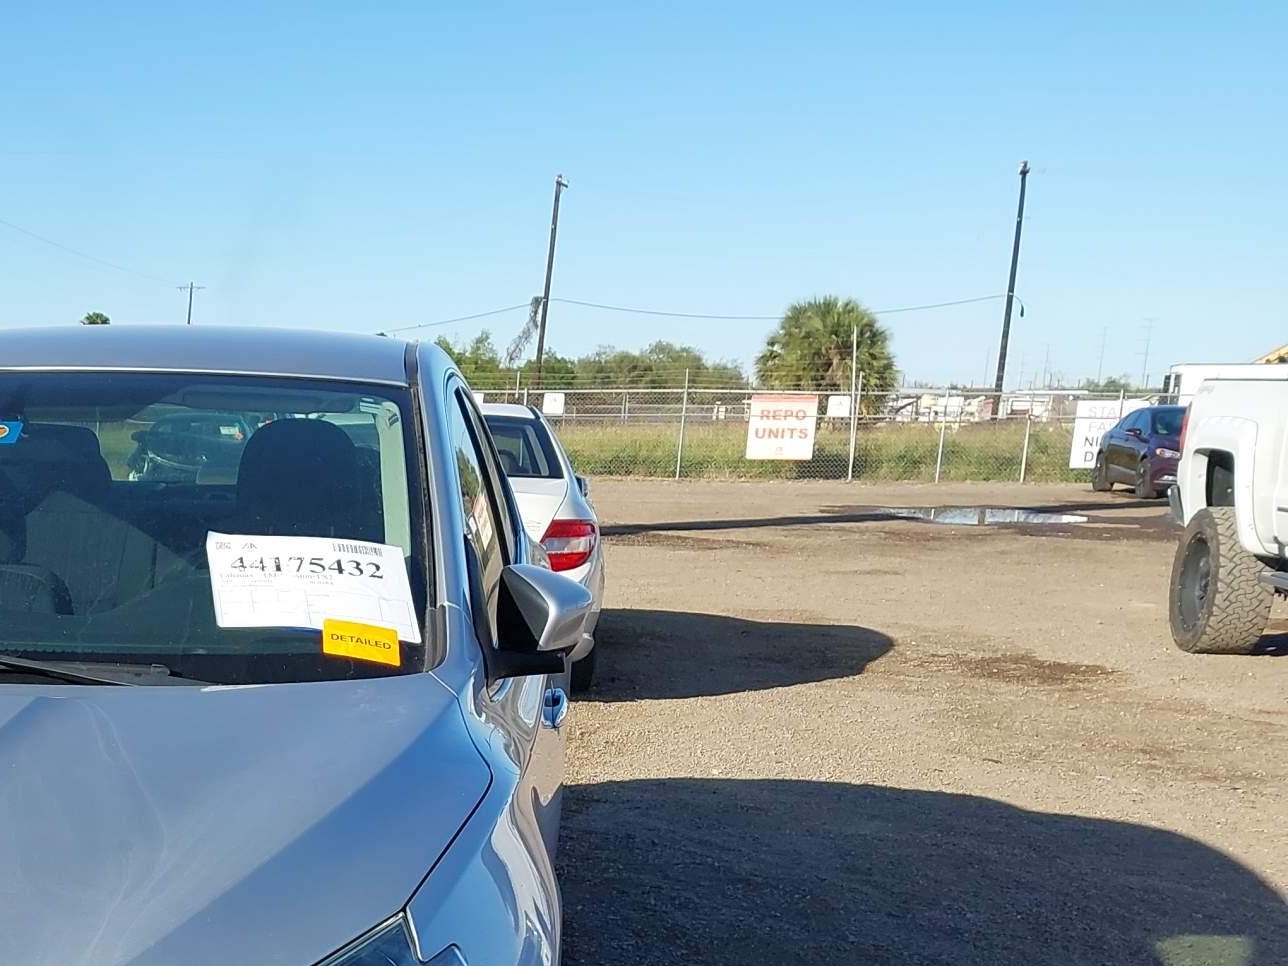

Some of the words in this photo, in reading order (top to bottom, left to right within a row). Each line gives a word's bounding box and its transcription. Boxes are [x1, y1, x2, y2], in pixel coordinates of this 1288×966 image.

[760, 409, 807, 421] REPO
[755, 428, 808, 439] UNITS
[230, 556, 384, 580] 44175432
[330, 633, 392, 650] DETAILED
